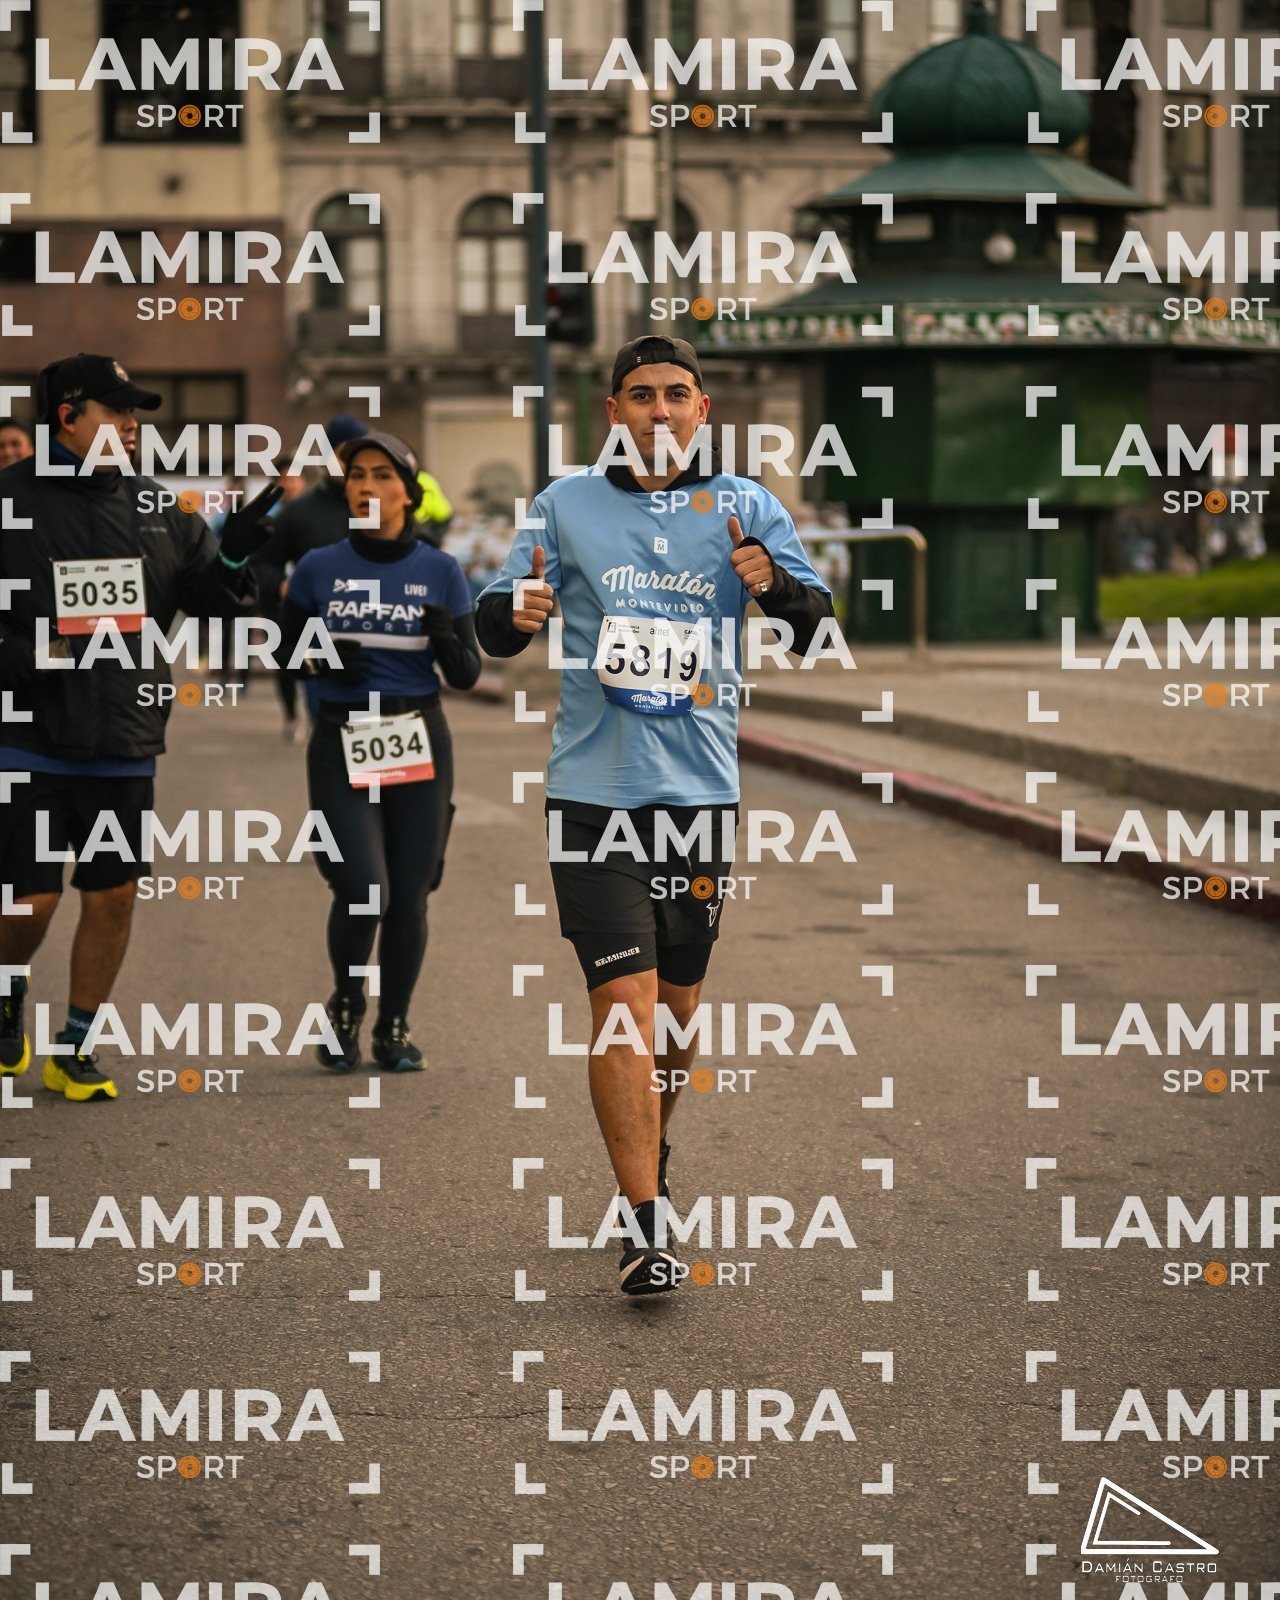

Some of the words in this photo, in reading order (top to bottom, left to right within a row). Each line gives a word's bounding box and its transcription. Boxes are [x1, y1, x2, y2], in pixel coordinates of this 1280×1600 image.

[62, 580, 138, 607] 5035
[602, 565, 716, 600] Maratón
[615, 598, 705, 614] MONTEVIDEO
[327, 619, 413, 633] SPORT
[605, 642, 697, 681] 5819
[351, 731, 423, 764] 5034
